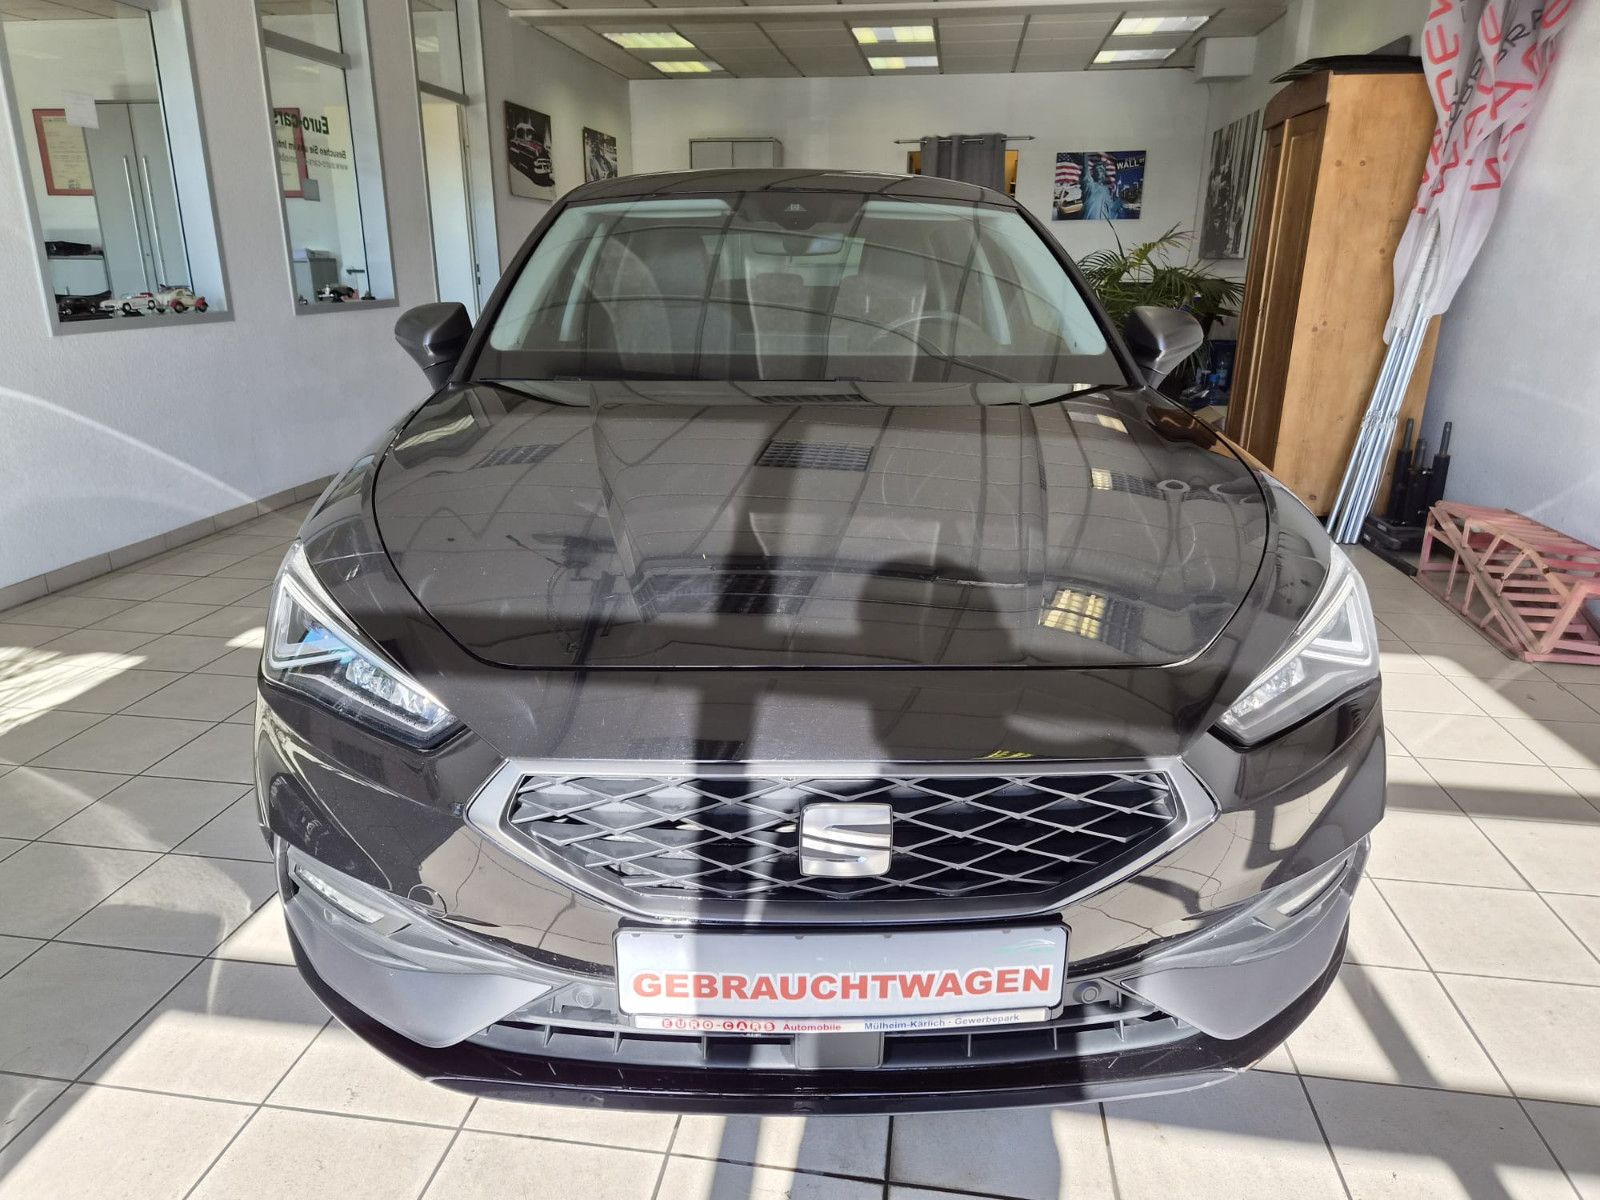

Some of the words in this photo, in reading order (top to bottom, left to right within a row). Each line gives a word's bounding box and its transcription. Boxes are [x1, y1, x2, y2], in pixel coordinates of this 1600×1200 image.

[1116, 160, 1139, 170] WALL
[633, 967, 1050, 1000] GEBRAUCHTWAGEN
[661, 1017, 775, 1032] EURO-CARS
[783, 1022, 842, 1032] Automobile
[864, 1019, 945, 1031] Mülheim-Kärlich
[954, 1014, 1020, 1026] Gewerbepark
